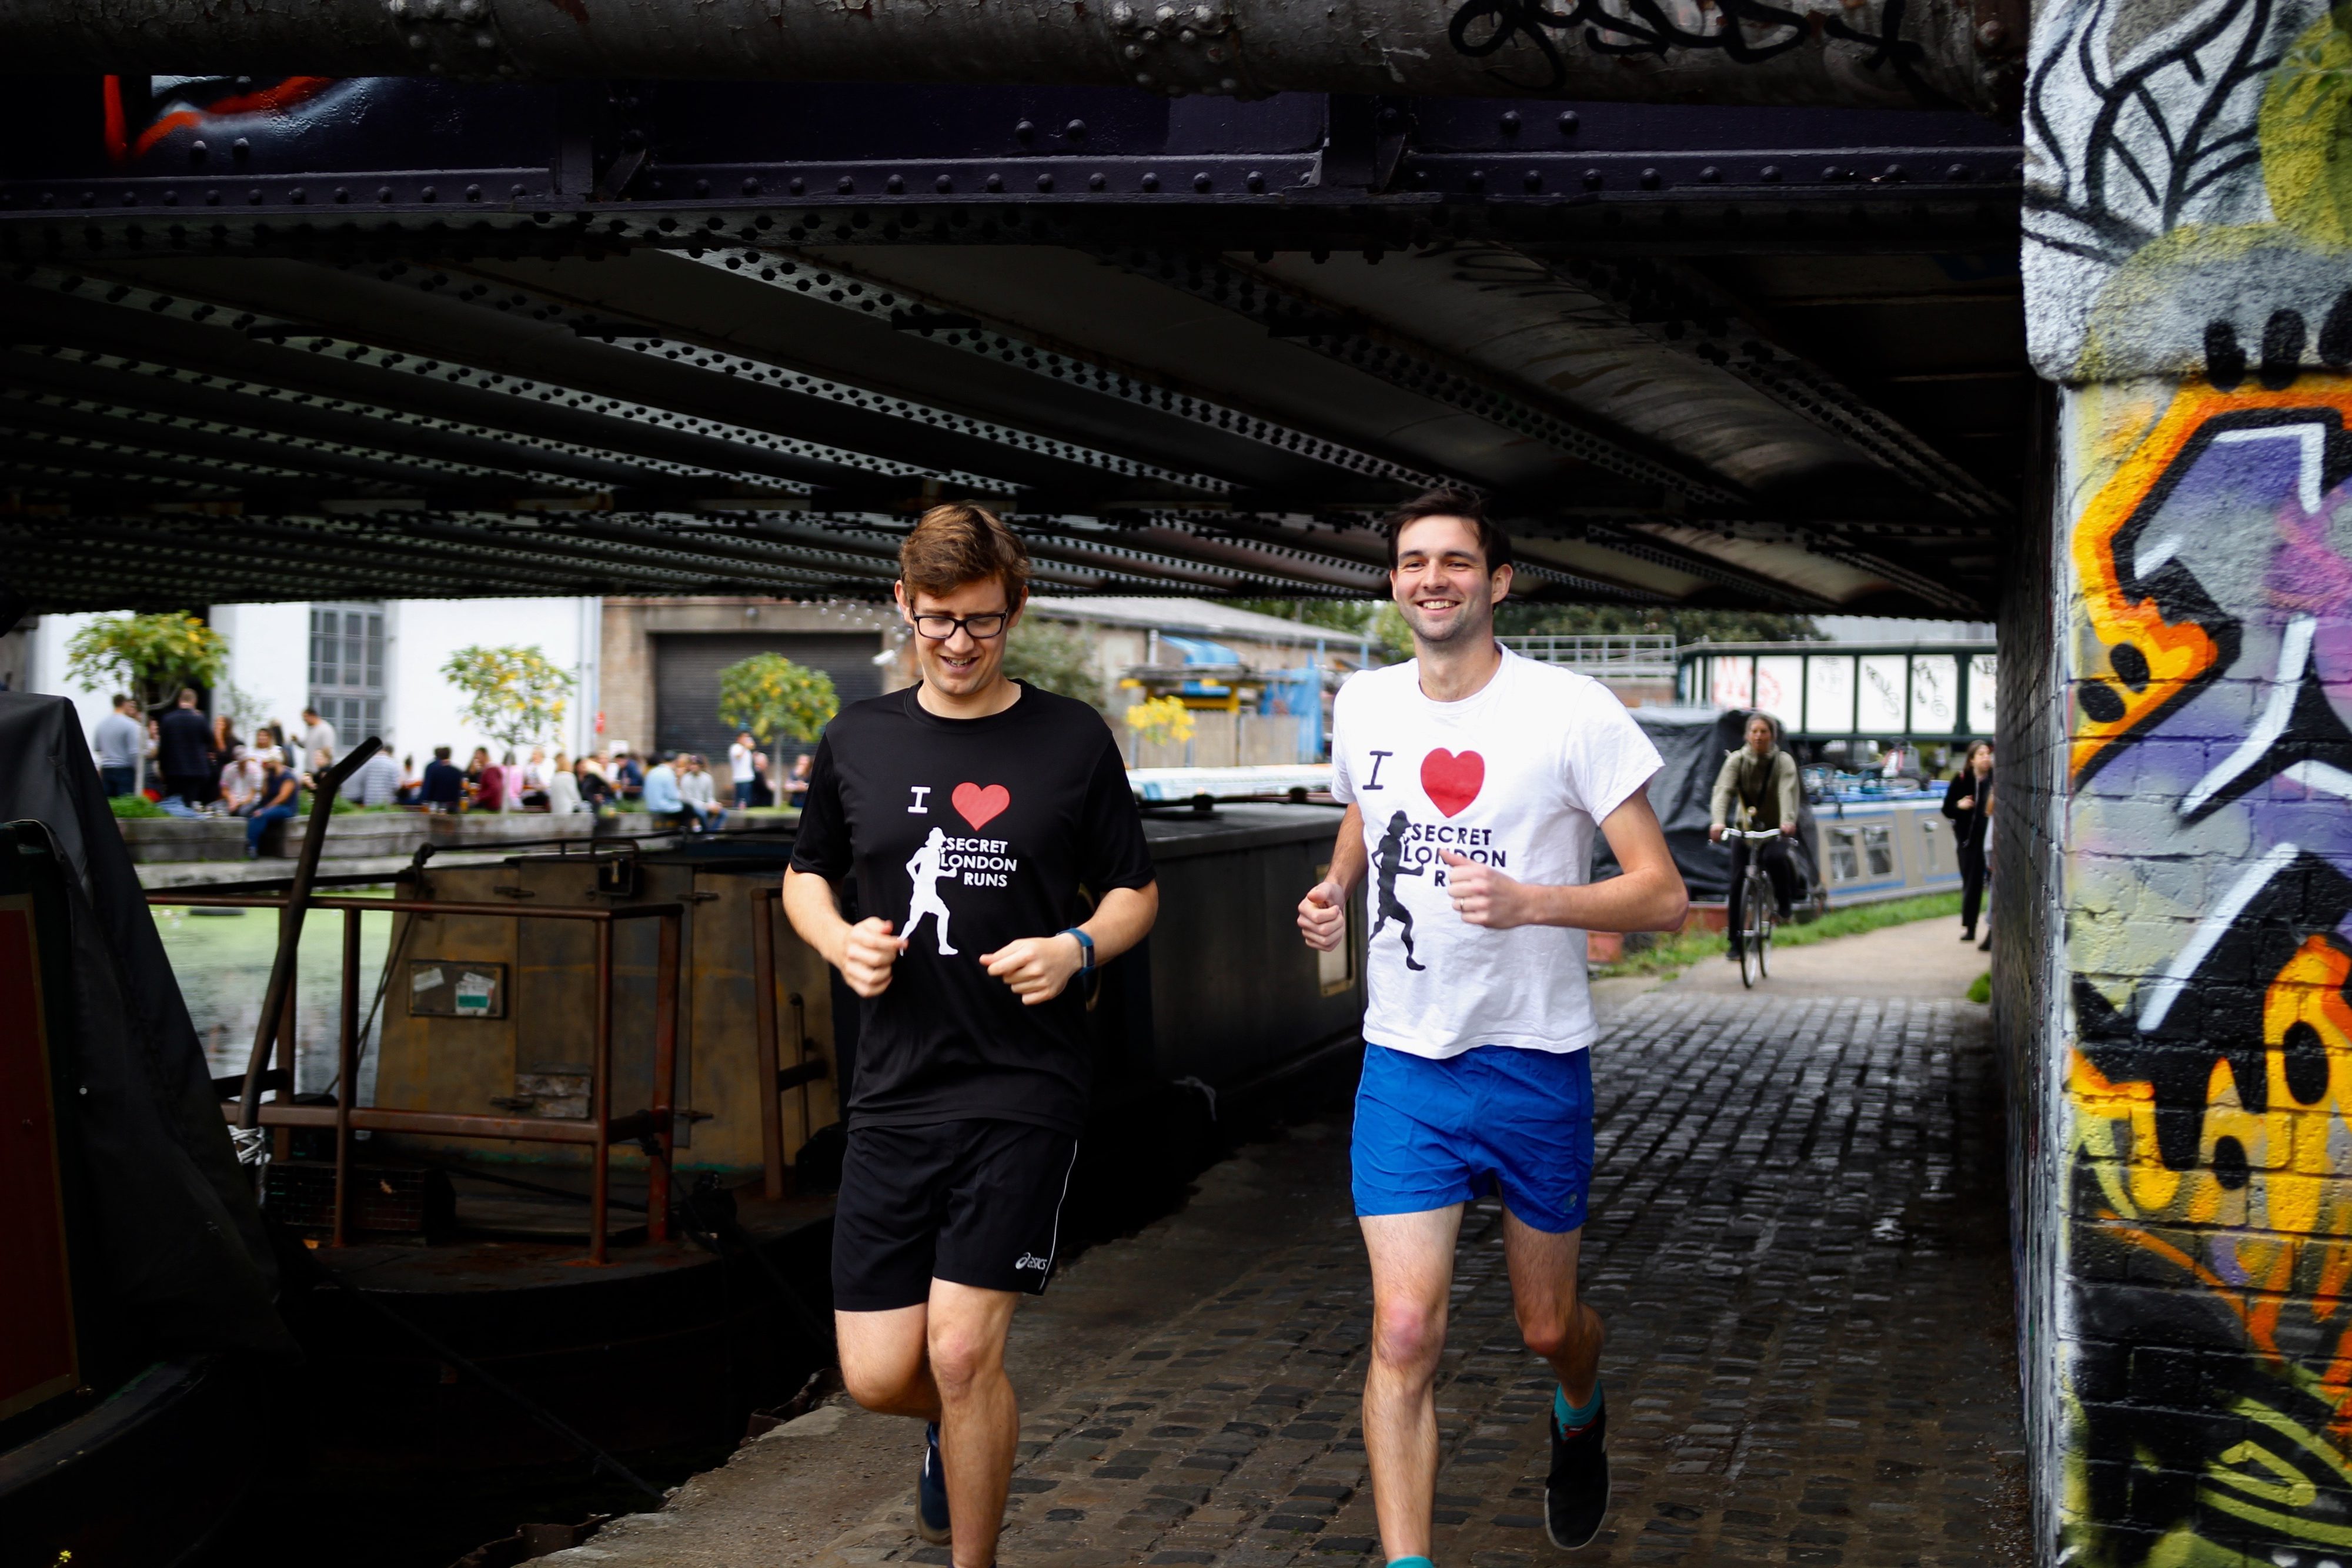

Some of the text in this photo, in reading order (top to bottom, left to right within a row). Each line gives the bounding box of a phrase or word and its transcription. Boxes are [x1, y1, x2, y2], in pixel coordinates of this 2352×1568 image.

[1362, 750, 1393, 790] I
[907, 786, 931, 814] I
[1411, 823, 1492, 845] SECRET
[946, 837, 1008, 854] SECRET
[941, 854, 1017, 872] LONDON
[964, 872, 1008, 887] RUNS
